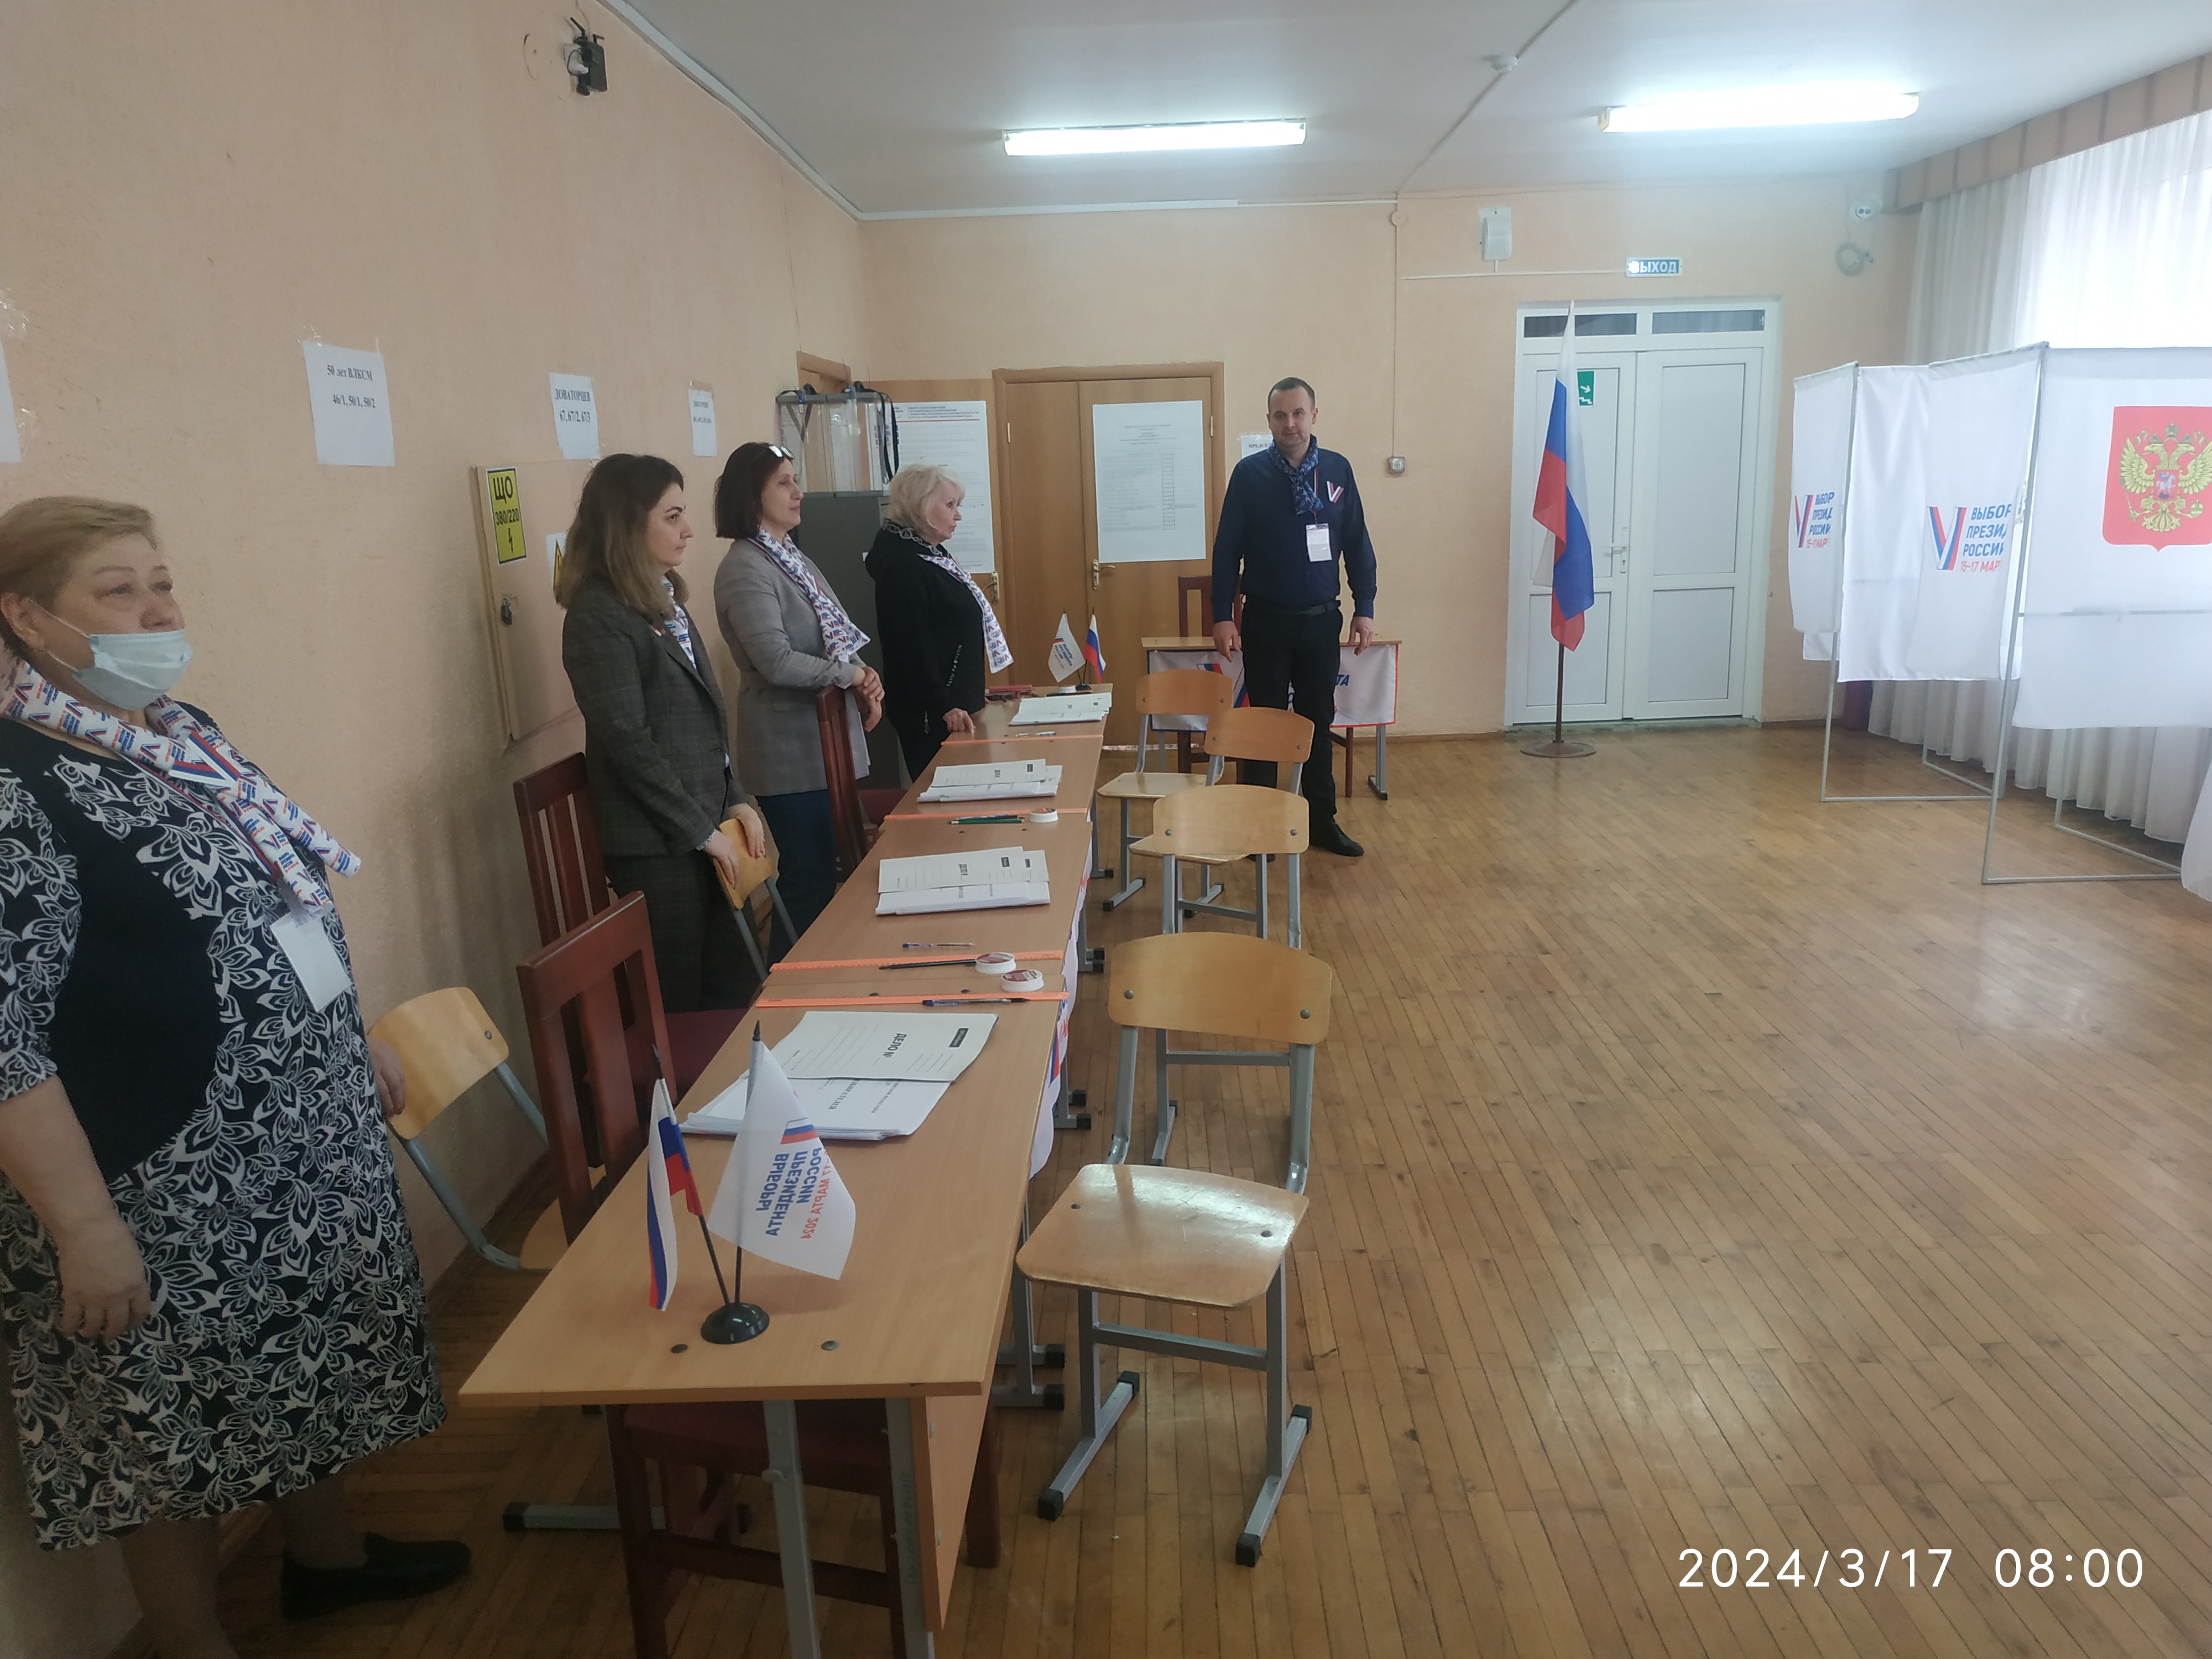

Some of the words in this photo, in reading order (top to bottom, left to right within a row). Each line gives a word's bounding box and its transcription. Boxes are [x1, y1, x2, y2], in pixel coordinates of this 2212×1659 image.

[1628, 260, 1677, 273] ВЫХОД
[327, 364, 335, 376] 50
[336, 368, 347, 377] лет
[555, 388, 591, 402] ДОВАТОРЦЕВ
[493, 476, 513, 504] ЩО
[495, 508, 520, 525] 380/220
[888, 1033, 907, 1051] ДЕЛО
